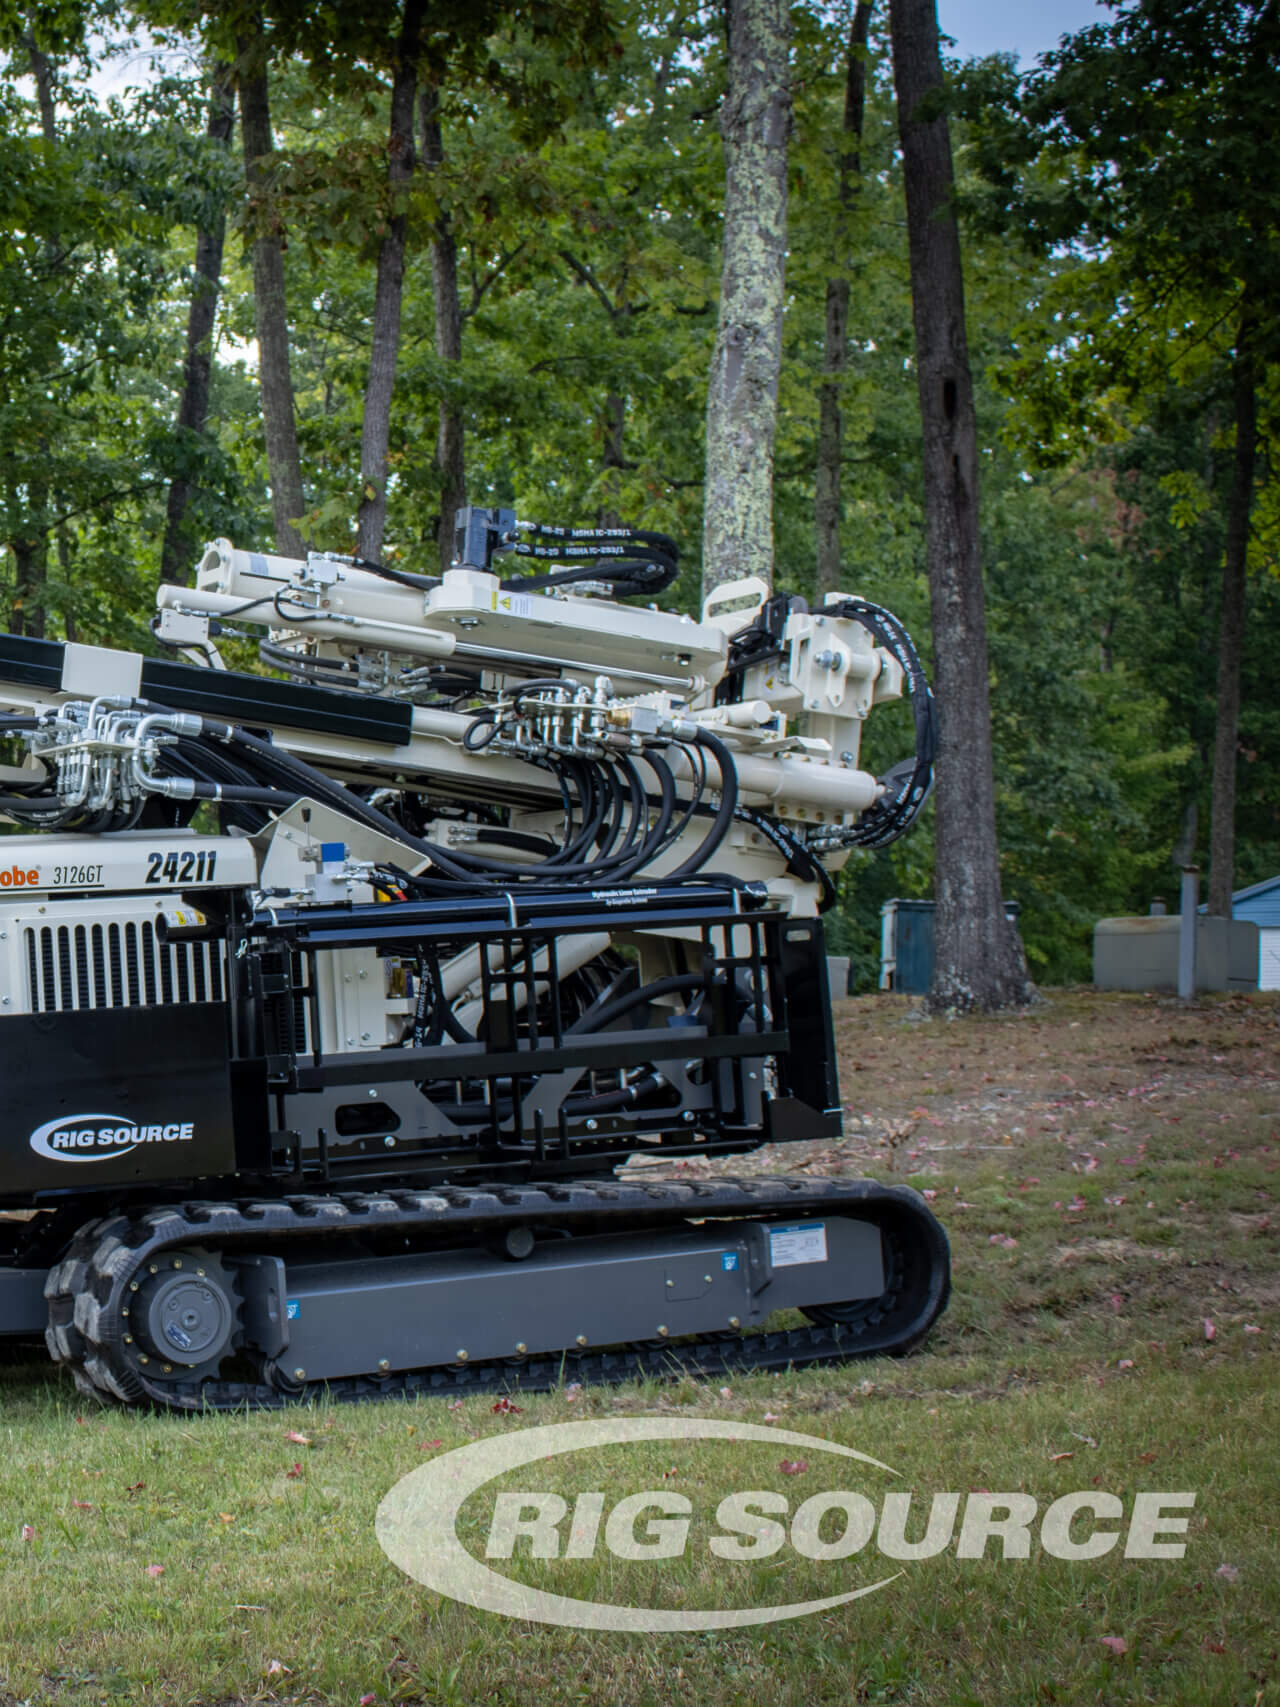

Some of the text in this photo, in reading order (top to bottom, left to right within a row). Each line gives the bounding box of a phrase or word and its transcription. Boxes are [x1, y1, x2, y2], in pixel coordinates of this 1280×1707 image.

[53, 865, 104, 885] 3126GT
[145, 850, 217, 884] 24211
[53, 1123, 194, 1148] RIG SOURCE
